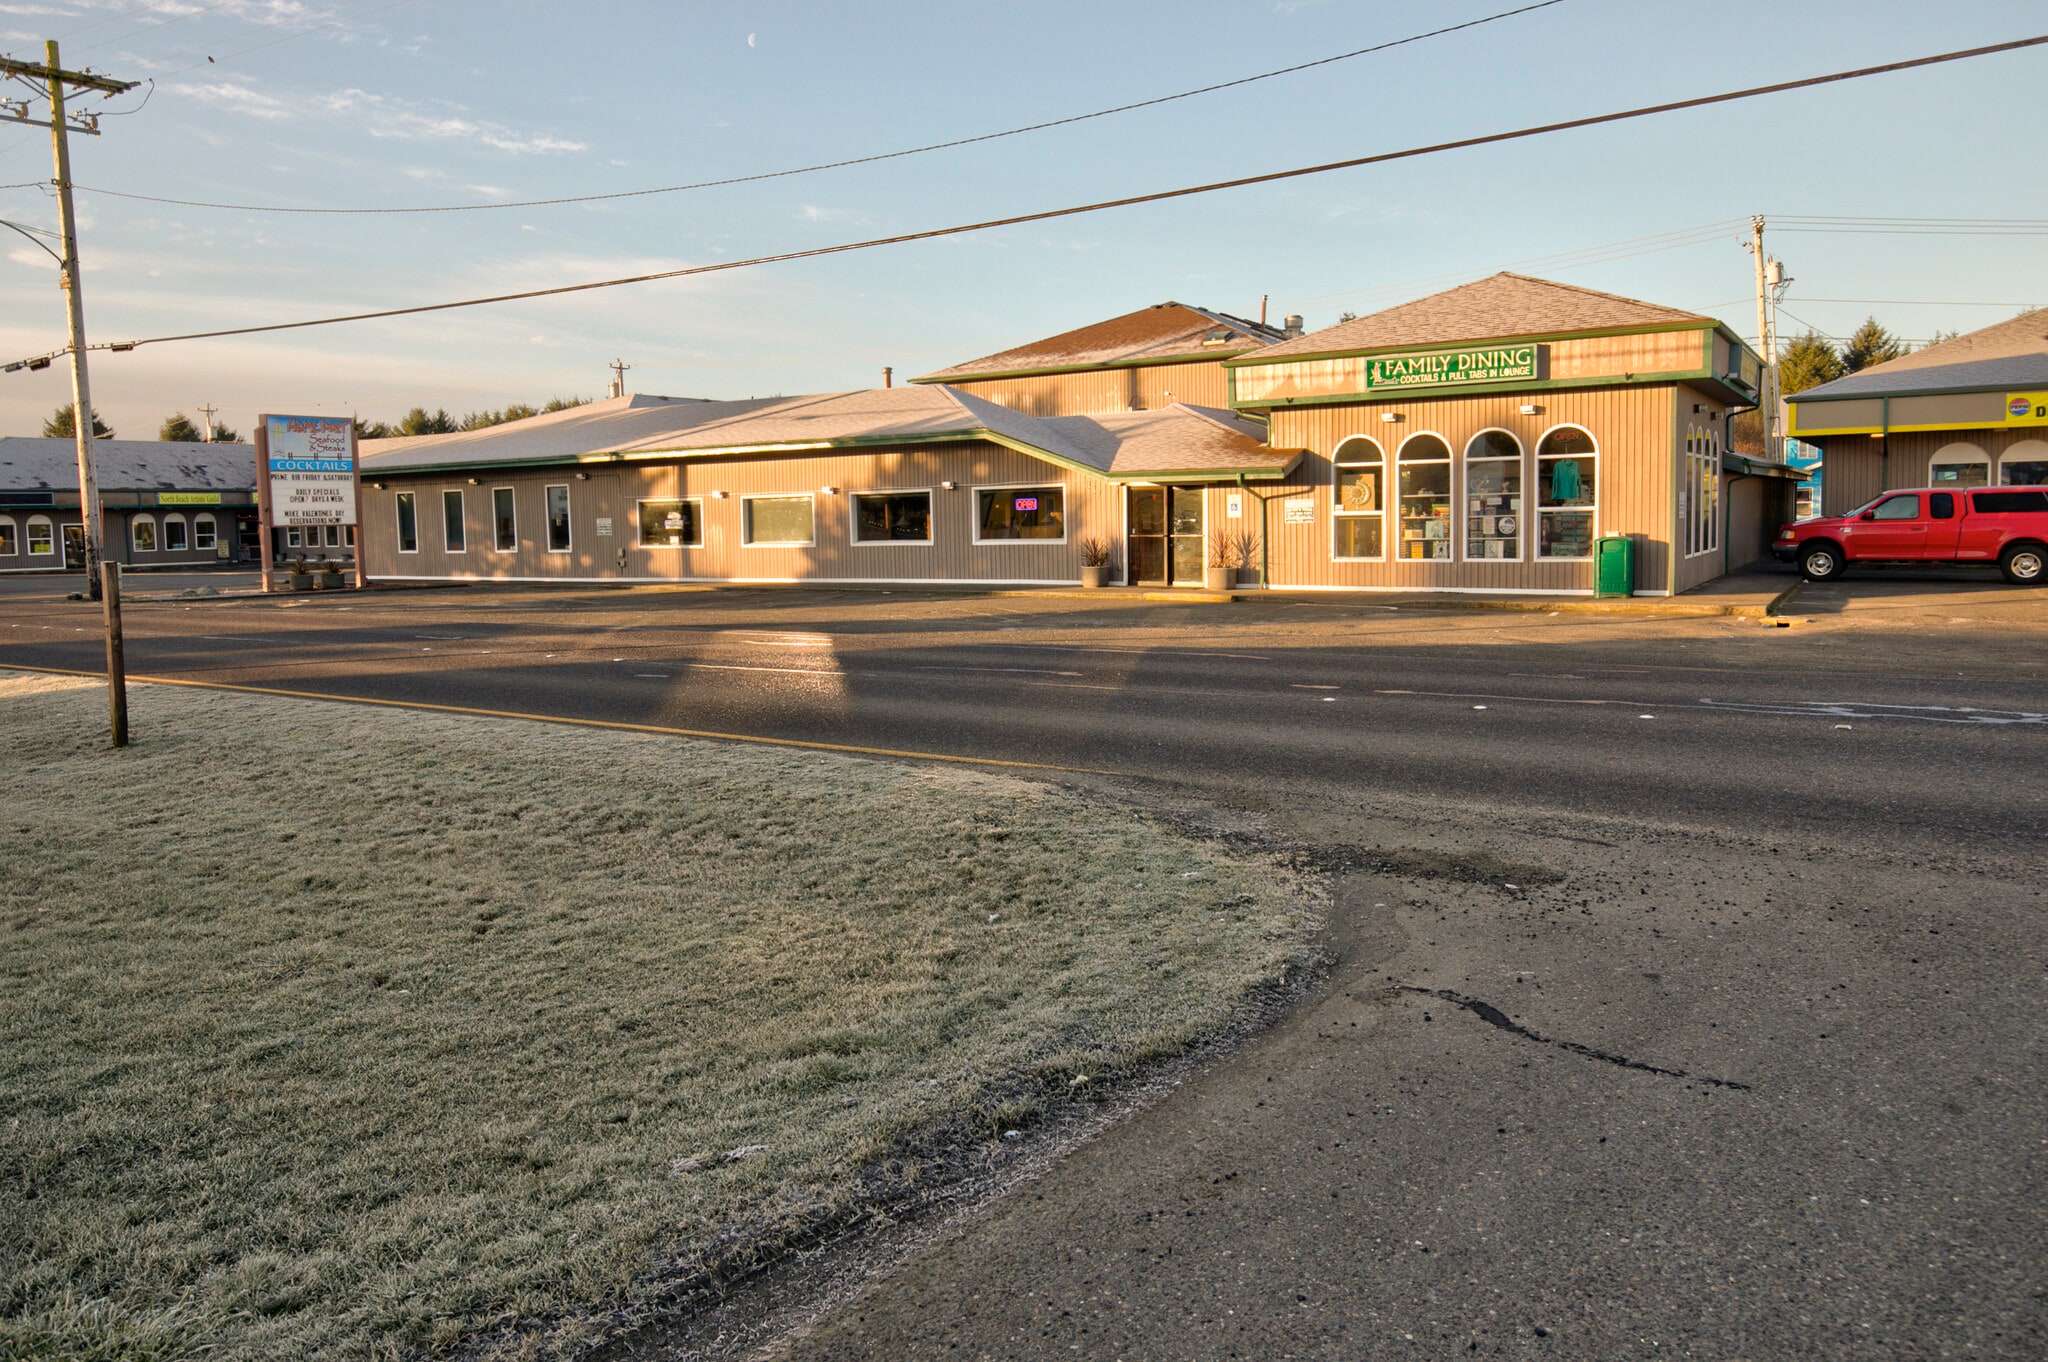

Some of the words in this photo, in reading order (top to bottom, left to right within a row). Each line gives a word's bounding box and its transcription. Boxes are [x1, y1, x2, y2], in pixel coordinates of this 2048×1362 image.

[1385, 355, 1451, 376] FAMILY
[1458, 349, 1531, 370] DINING
[1400, 373, 1439, 385] COCKTAILS
[1440, 372, 1446, 381] &
[1449, 371, 1467, 381] PULL
[1469, 370, 1487, 379] TABS
[1489, 368, 1497, 377] IN
[1500, 366, 1530, 377] LOUNGE
[309, 433, 345, 444] Seafood
[1554, 432, 1579, 440] OPEN
[309, 444, 316, 452] &
[316, 443, 346, 452] Steaks
[277, 461, 348, 471] COCKTAILS
[160, 495, 175, 503] North
[175, 495, 189, 503] Beach
[206, 495, 220, 503] Guild
[1017, 500, 1035, 509] OPEN
